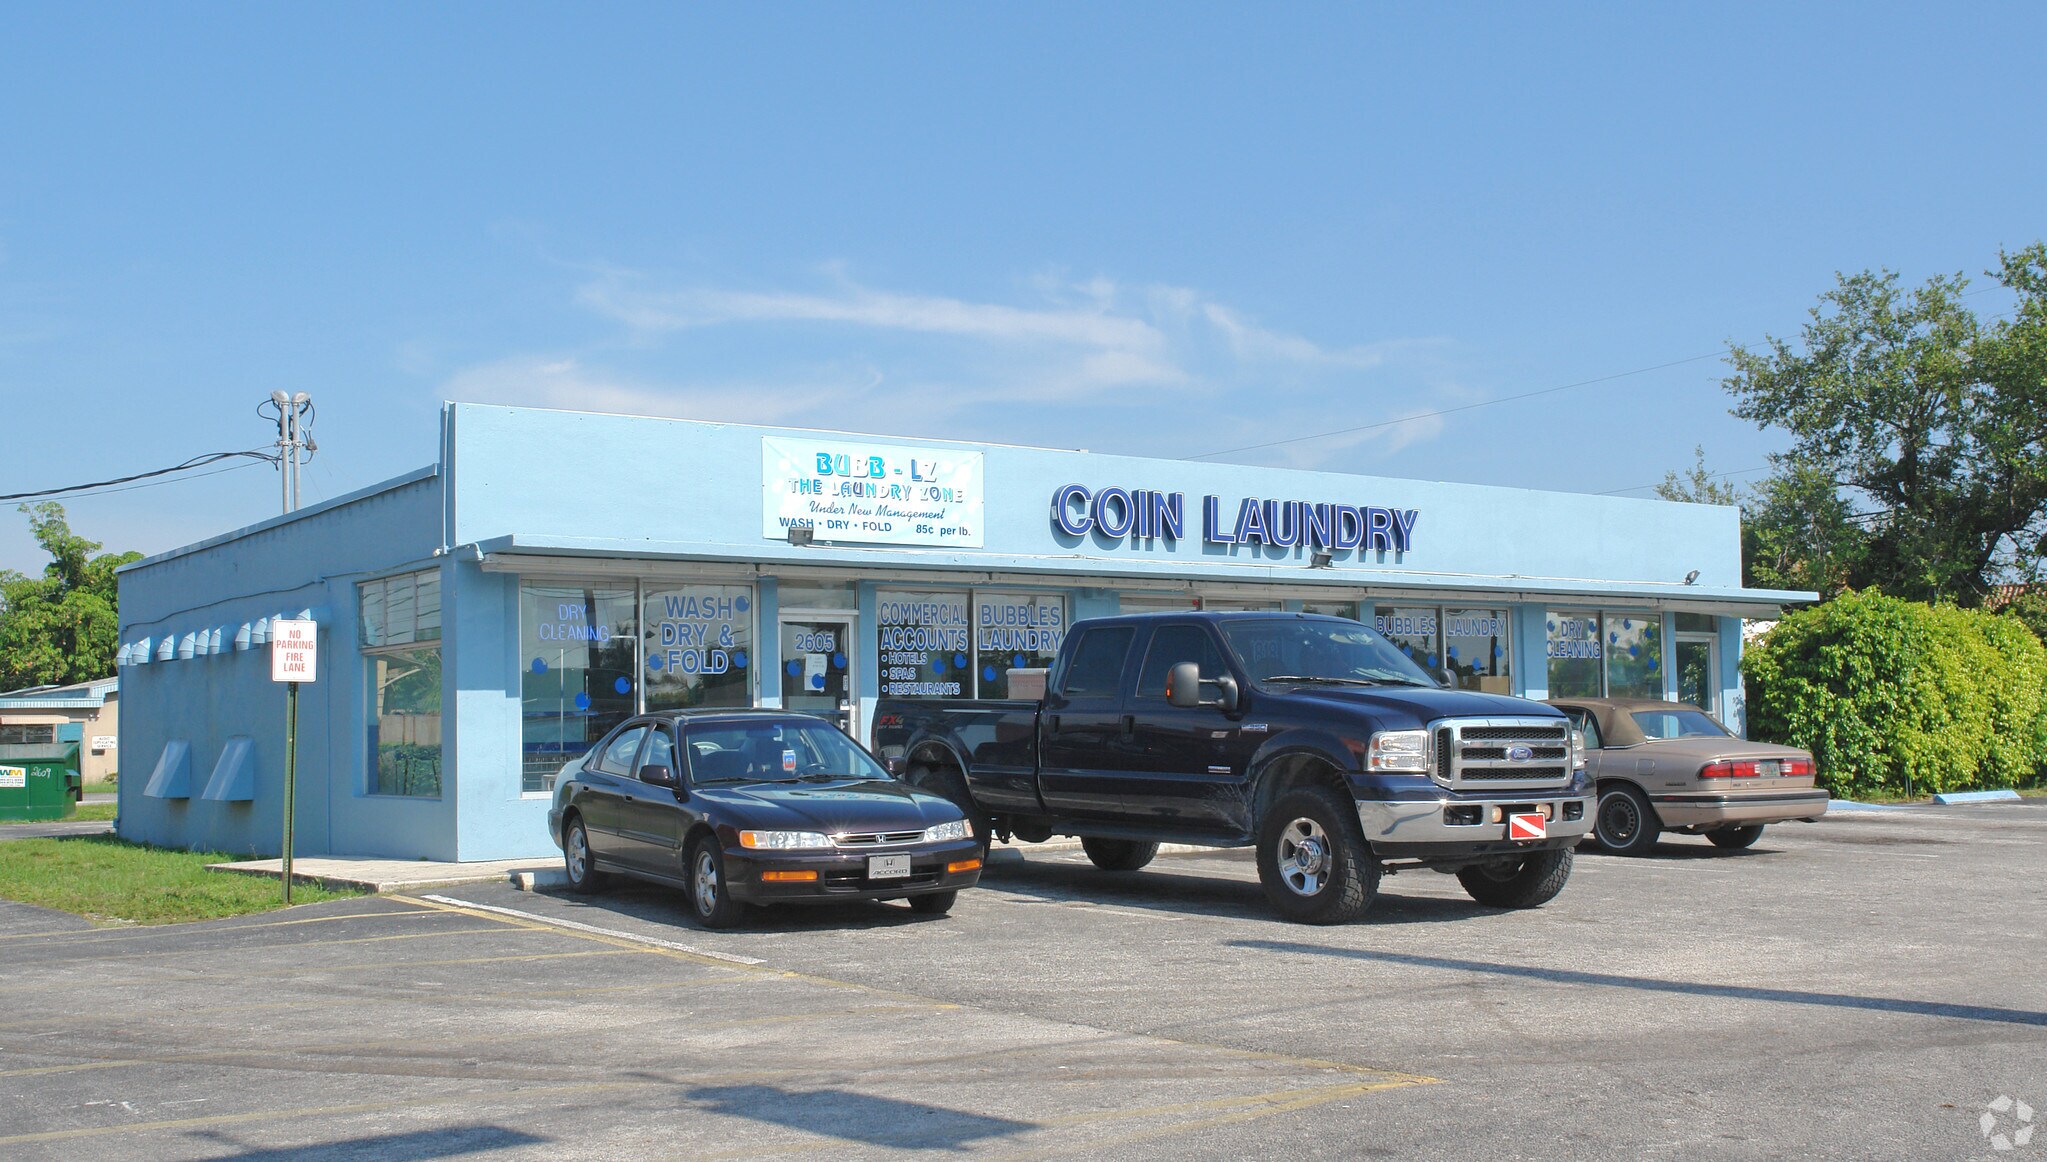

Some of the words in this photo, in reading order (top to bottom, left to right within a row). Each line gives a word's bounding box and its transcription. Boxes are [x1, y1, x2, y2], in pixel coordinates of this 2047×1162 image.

[815, 452, 886, 479] BUBB
[788, 477, 823, 496] THE
[832, 480, 912, 502] LAUNDRY
[920, 485, 964, 504] ZONE
[809, 500, 845, 515] Under
[848, 501, 872, 516] New
[874, 504, 945, 523] Management
[1051, 482, 1186, 541] COIN
[1203, 494, 1421, 553] LAUNDRY
[779, 516, 814, 529] WASH
[827, 519, 850, 531] DRY
[862, 521, 893, 533] FOLD
[940, 527, 957, 537] per
[958, 526, 972, 537] lb.
[558, 603, 588, 621] DRY
[664, 595, 734, 621] WASH
[879, 601, 969, 625] COMMERCIAL
[980, 603, 1061, 627] BUBBLES
[289, 629, 301, 639] NO
[539, 622, 611, 642] CLEANING
[660, 622, 707, 647] DRY
[718, 623, 735, 648] &
[1374, 615, 1438, 637] BUBBLES
[1446, 616, 1506, 638] LAUNDRY
[1560, 620, 1584, 639] DRY
[276, 640, 314, 650] PARKING
[794, 632, 835, 653] 2605
[880, 627, 969, 651] ACCOUNTS
[978, 628, 1062, 651] LAUNDRY
[1546, 639, 1601, 660] CLEANING
[283, 662, 305, 672] LANE
[286, 652, 303, 661] FIRE
[666, 649, 730, 675] FOLD
[888, 651, 928, 665] HOTELS
[889, 667, 916, 680] SPAS
[888, 682, 961, 696] RESTAURANTS
